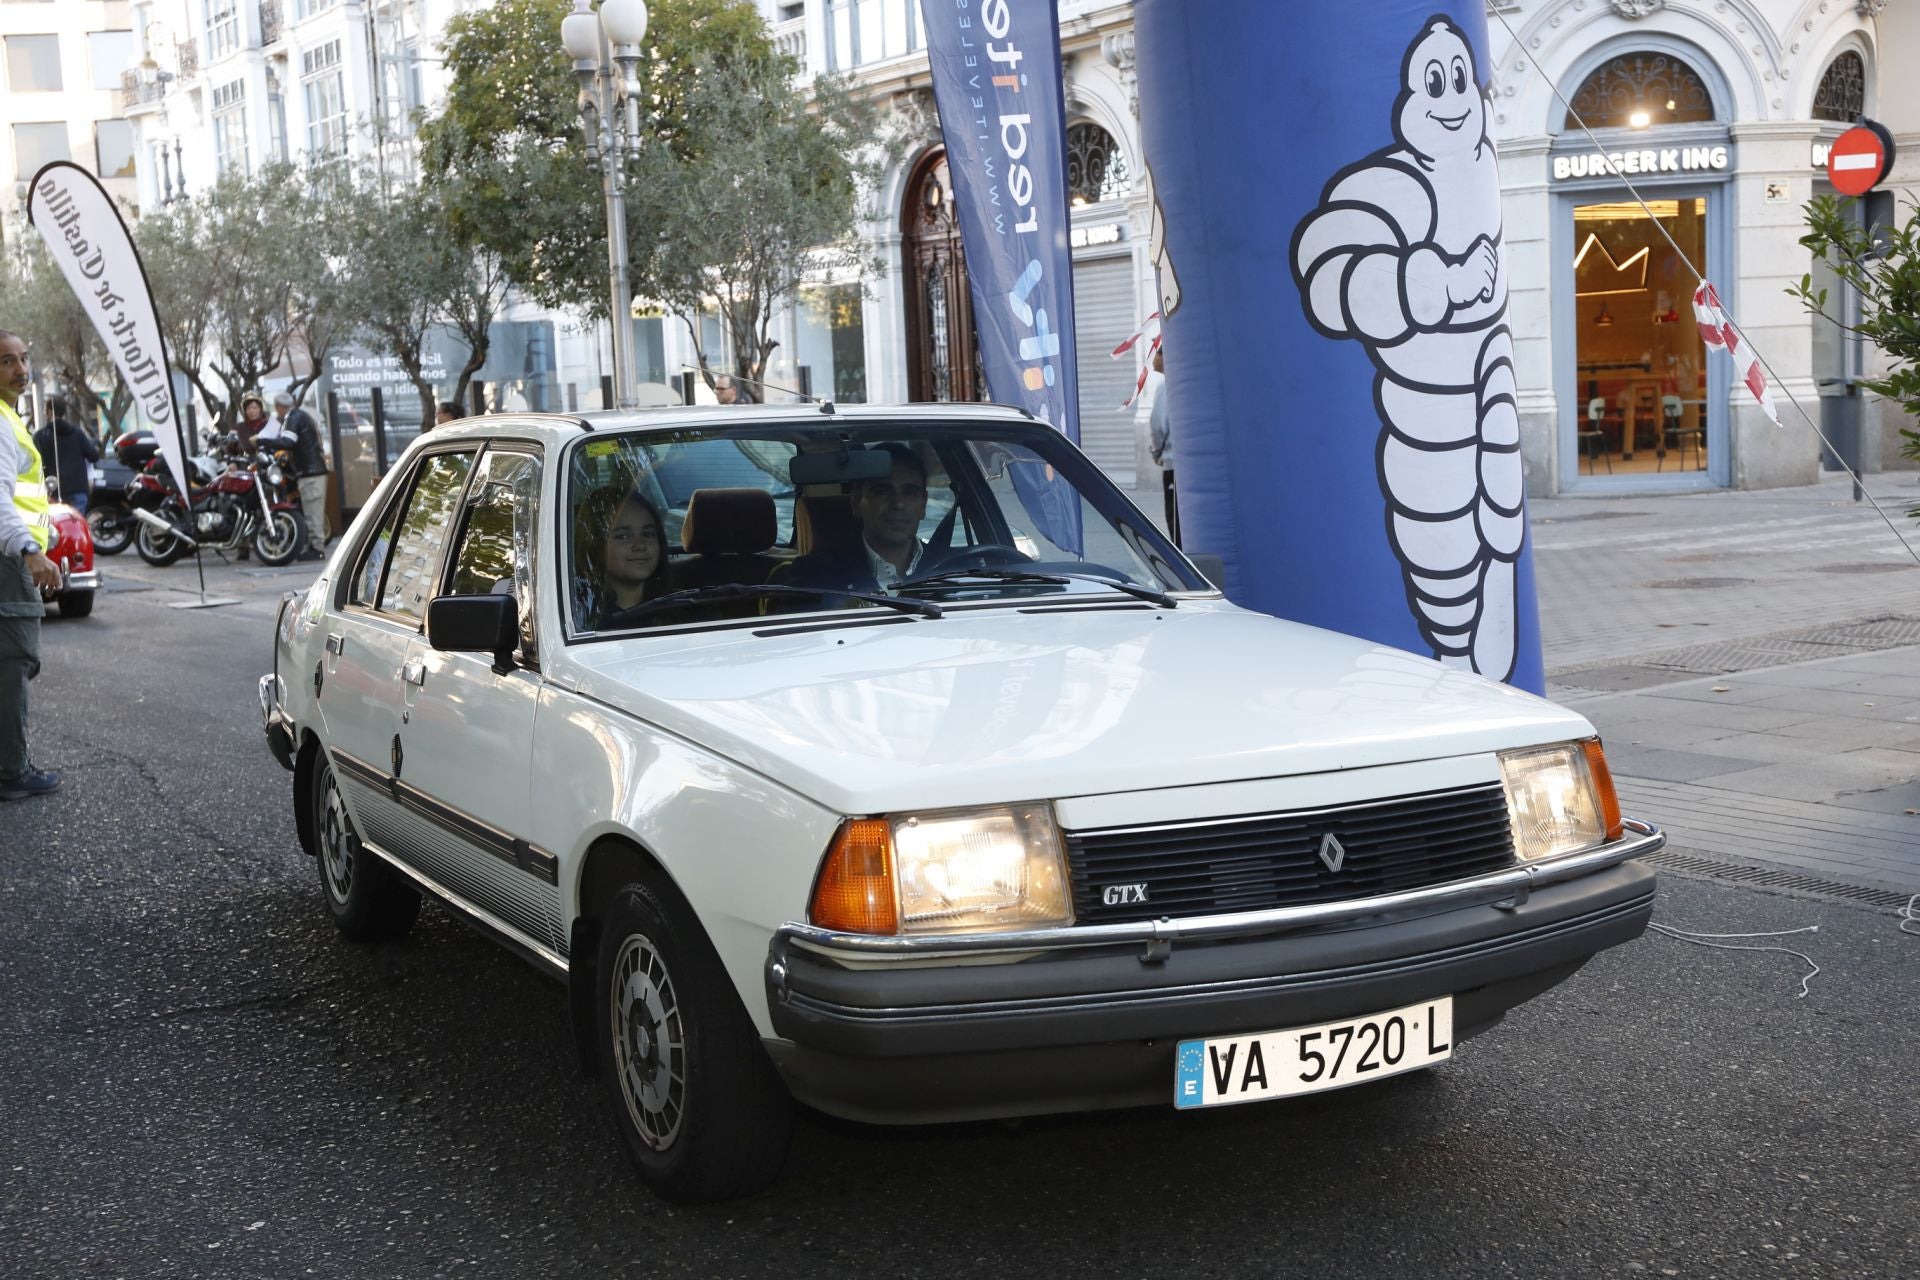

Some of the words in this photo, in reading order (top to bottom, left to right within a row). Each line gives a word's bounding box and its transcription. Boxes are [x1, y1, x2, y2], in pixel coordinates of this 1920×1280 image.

[1553, 149, 1658, 180] BURGER
[1660, 146, 1728, 172] KING
[330, 355, 363, 369] Todo
[366, 357, 381, 368] es
[333, 369, 381, 383] cuando
[384, 368, 447, 380] habmos
[349, 384, 392, 398] miso
[1103, 883, 1147, 905] GTX
[1184, 1080, 1197, 1096] E
[1209, 1041, 1268, 1095] VA
[1299, 1016, 1406, 1083] 5720
[1428, 1006, 1449, 1056] L
